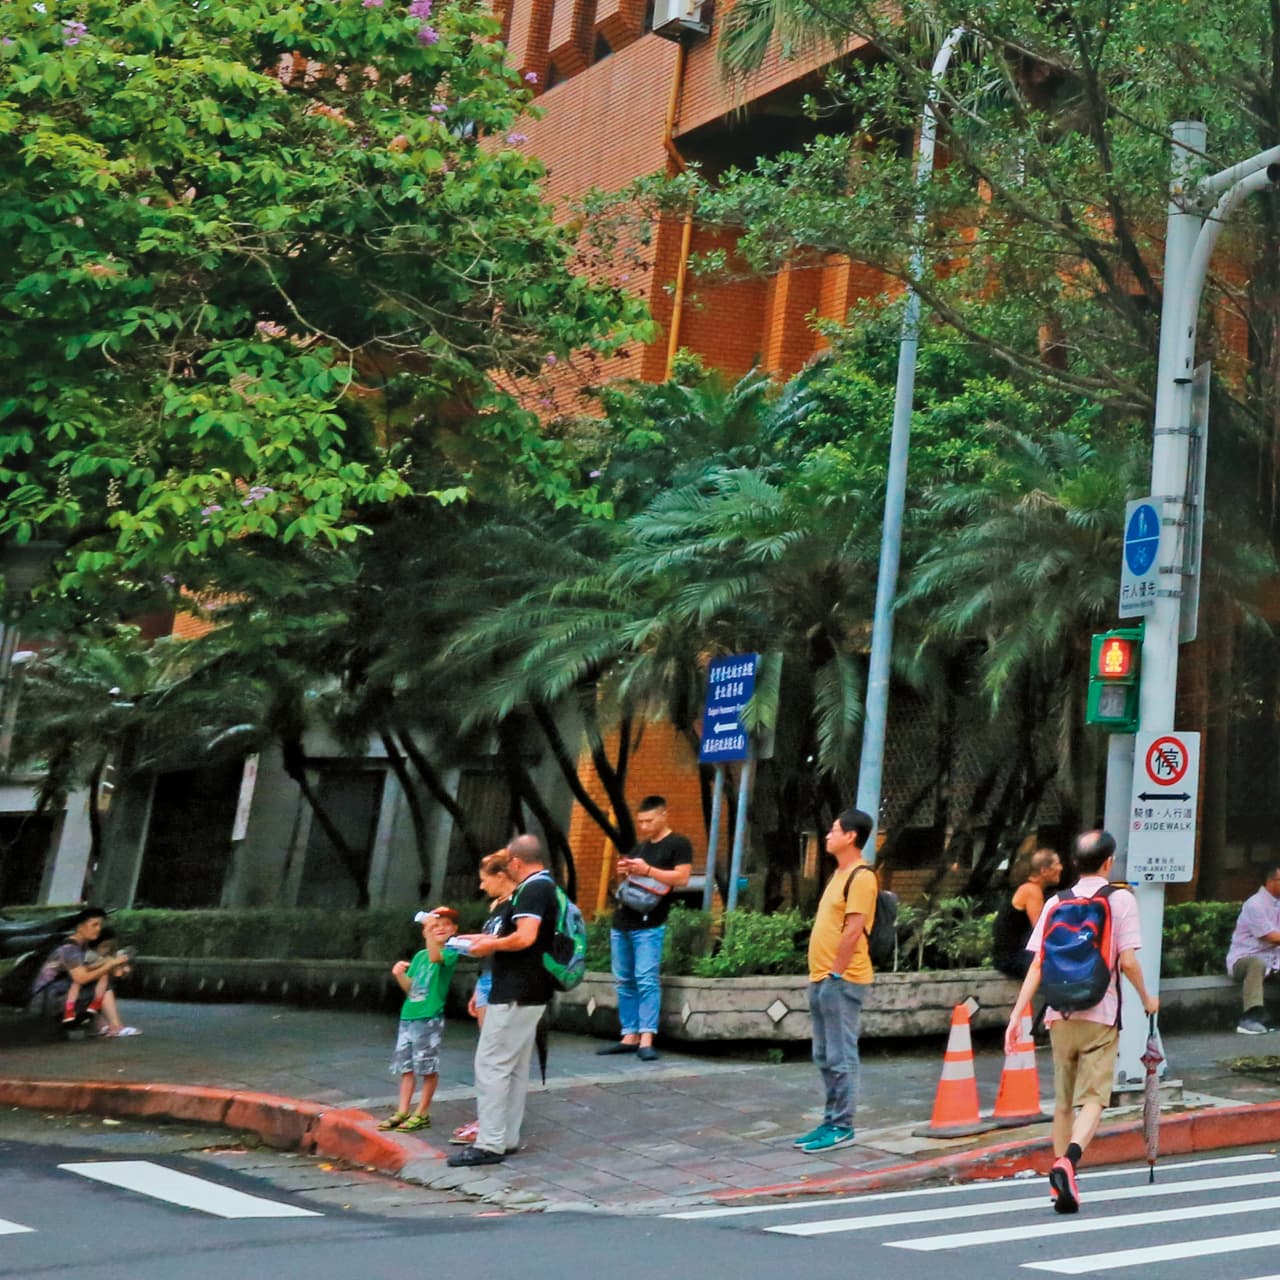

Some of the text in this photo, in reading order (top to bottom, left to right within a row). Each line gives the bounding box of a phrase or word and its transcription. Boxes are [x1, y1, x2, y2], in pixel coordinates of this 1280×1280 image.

[1122, 581, 1156, 600] 行人優先
[1143, 822, 1192, 831] SIDEWALK
[1160, 873, 1176, 881] 110
